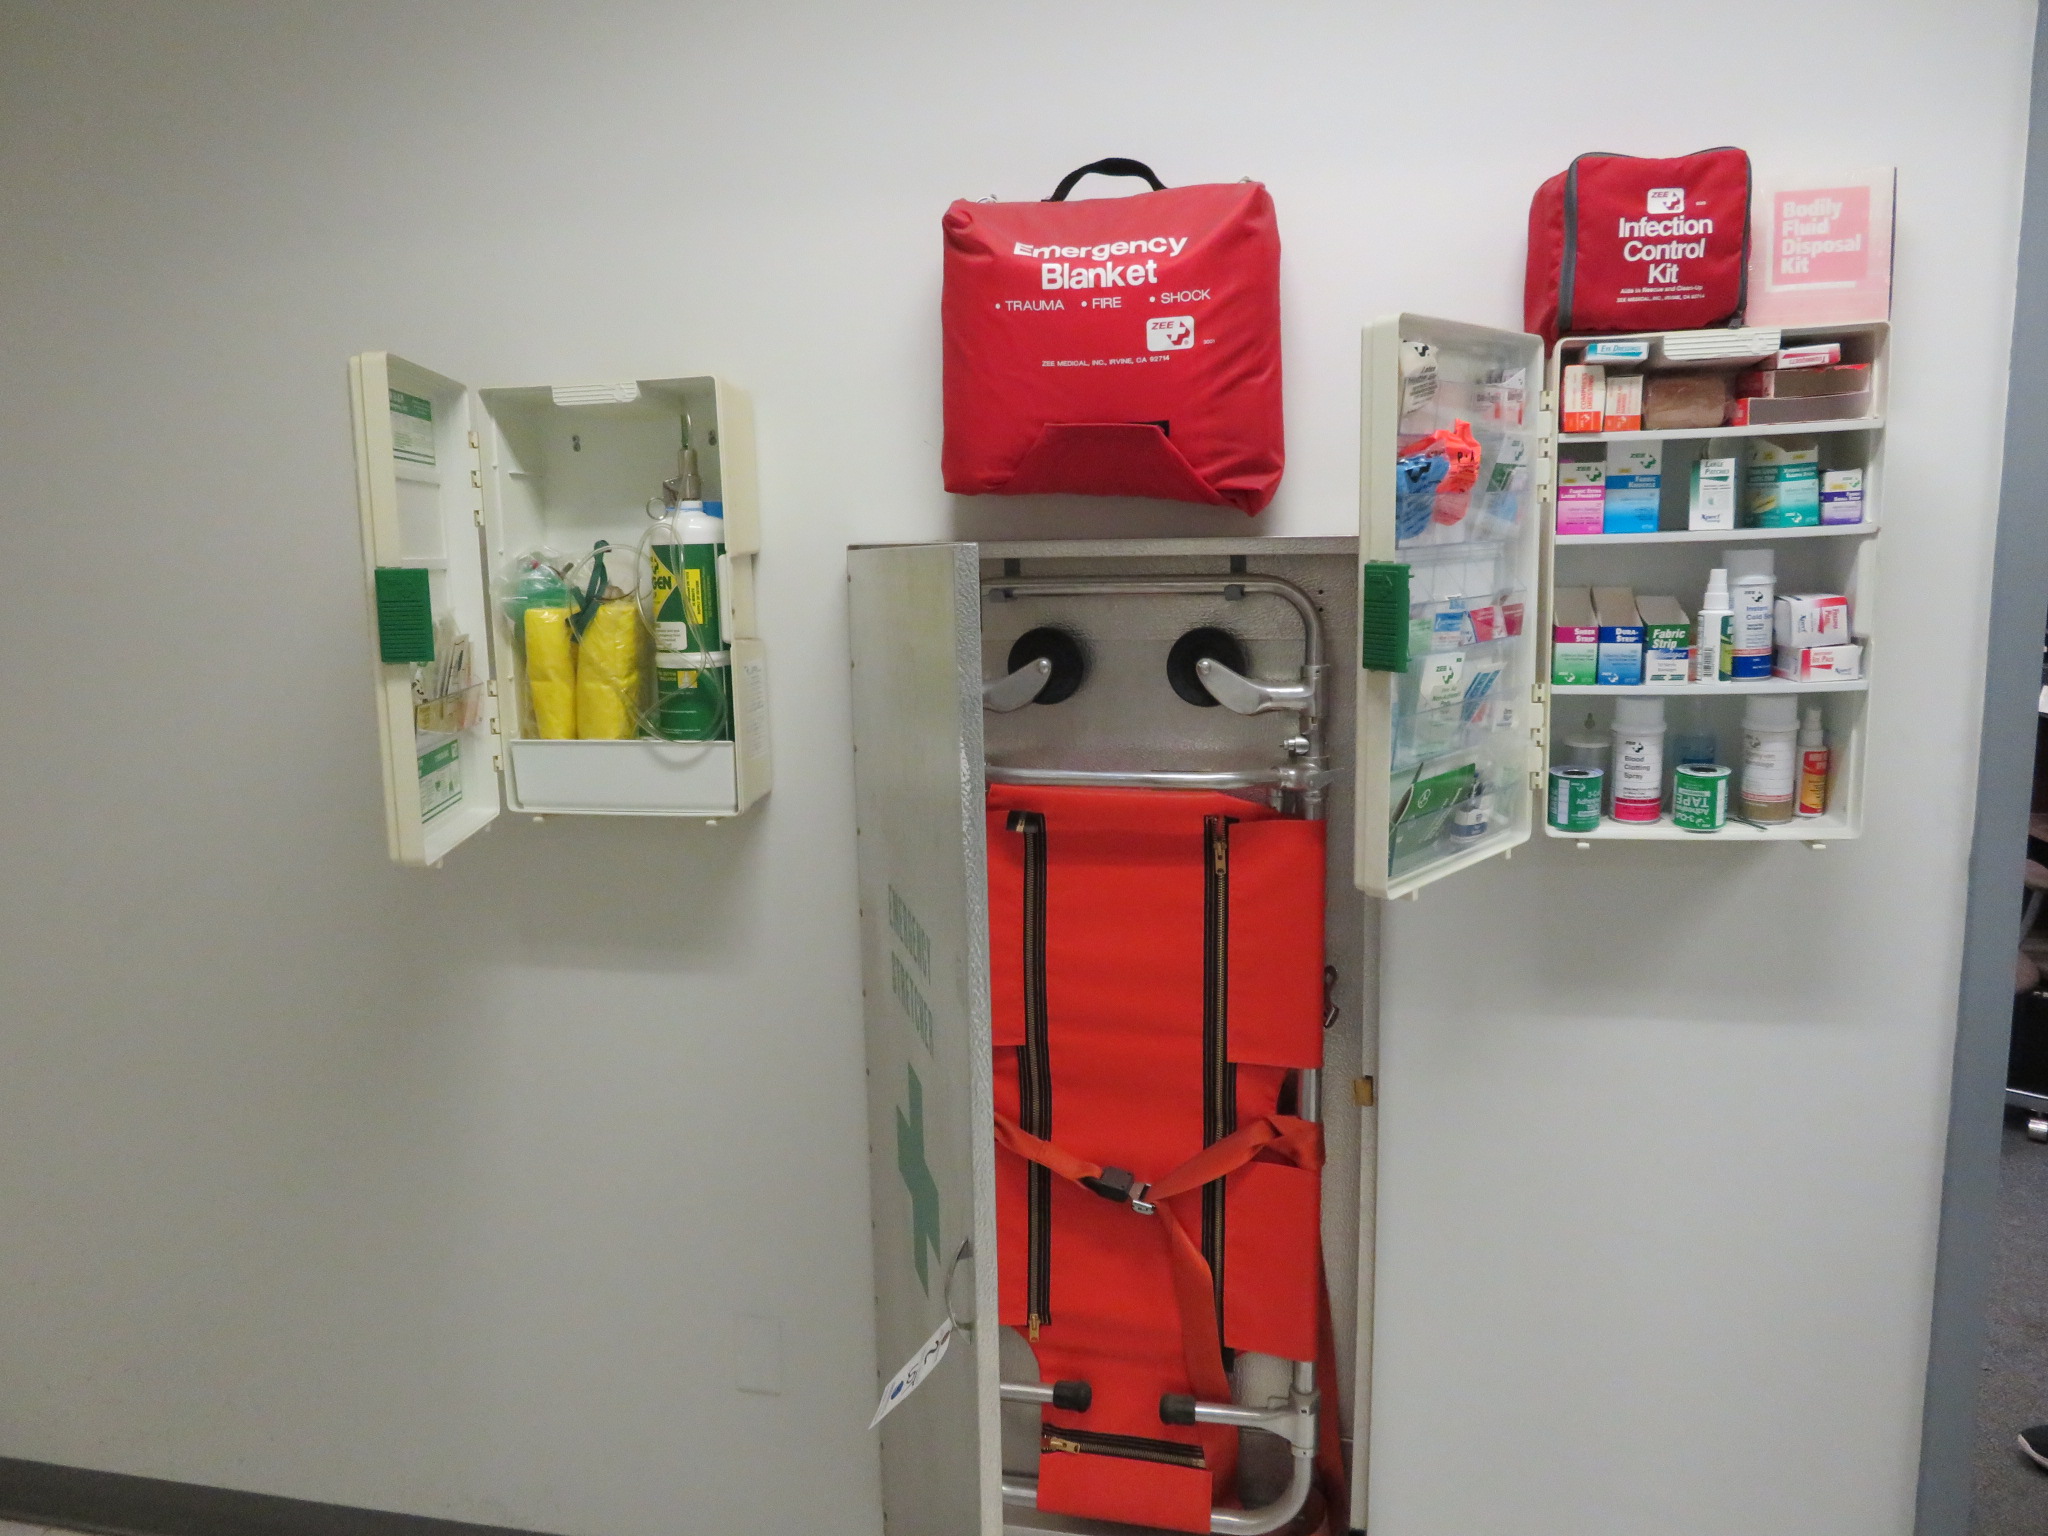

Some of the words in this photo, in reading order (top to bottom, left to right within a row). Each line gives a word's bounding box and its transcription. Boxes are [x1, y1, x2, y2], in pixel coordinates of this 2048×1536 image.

[1782, 198, 1843, 220] Bodily
[1619, 215, 1713, 238] Infection
[1782, 217, 1830, 237] Fluid
[1013, 236, 1188, 261] Emergency
[1624, 238, 1706, 262] Control
[1782, 234, 1861, 259] Disposal
[1041, 259, 1158, 290] Blanket
[1648, 263, 1679, 284] Kit
[1781, 256, 1809, 274] Kit
[1005, 299, 1065, 312] TRAUMA
[1092, 296, 1122, 309] FIRE
[1160, 289, 1211, 304] SHOCK
[1151, 321, 1174, 330] ZEE
[1653, 628, 1685, 639] Fabric
[1652, 639, 1677, 650] Strip
[1675, 794, 1709, 808] TAPE
